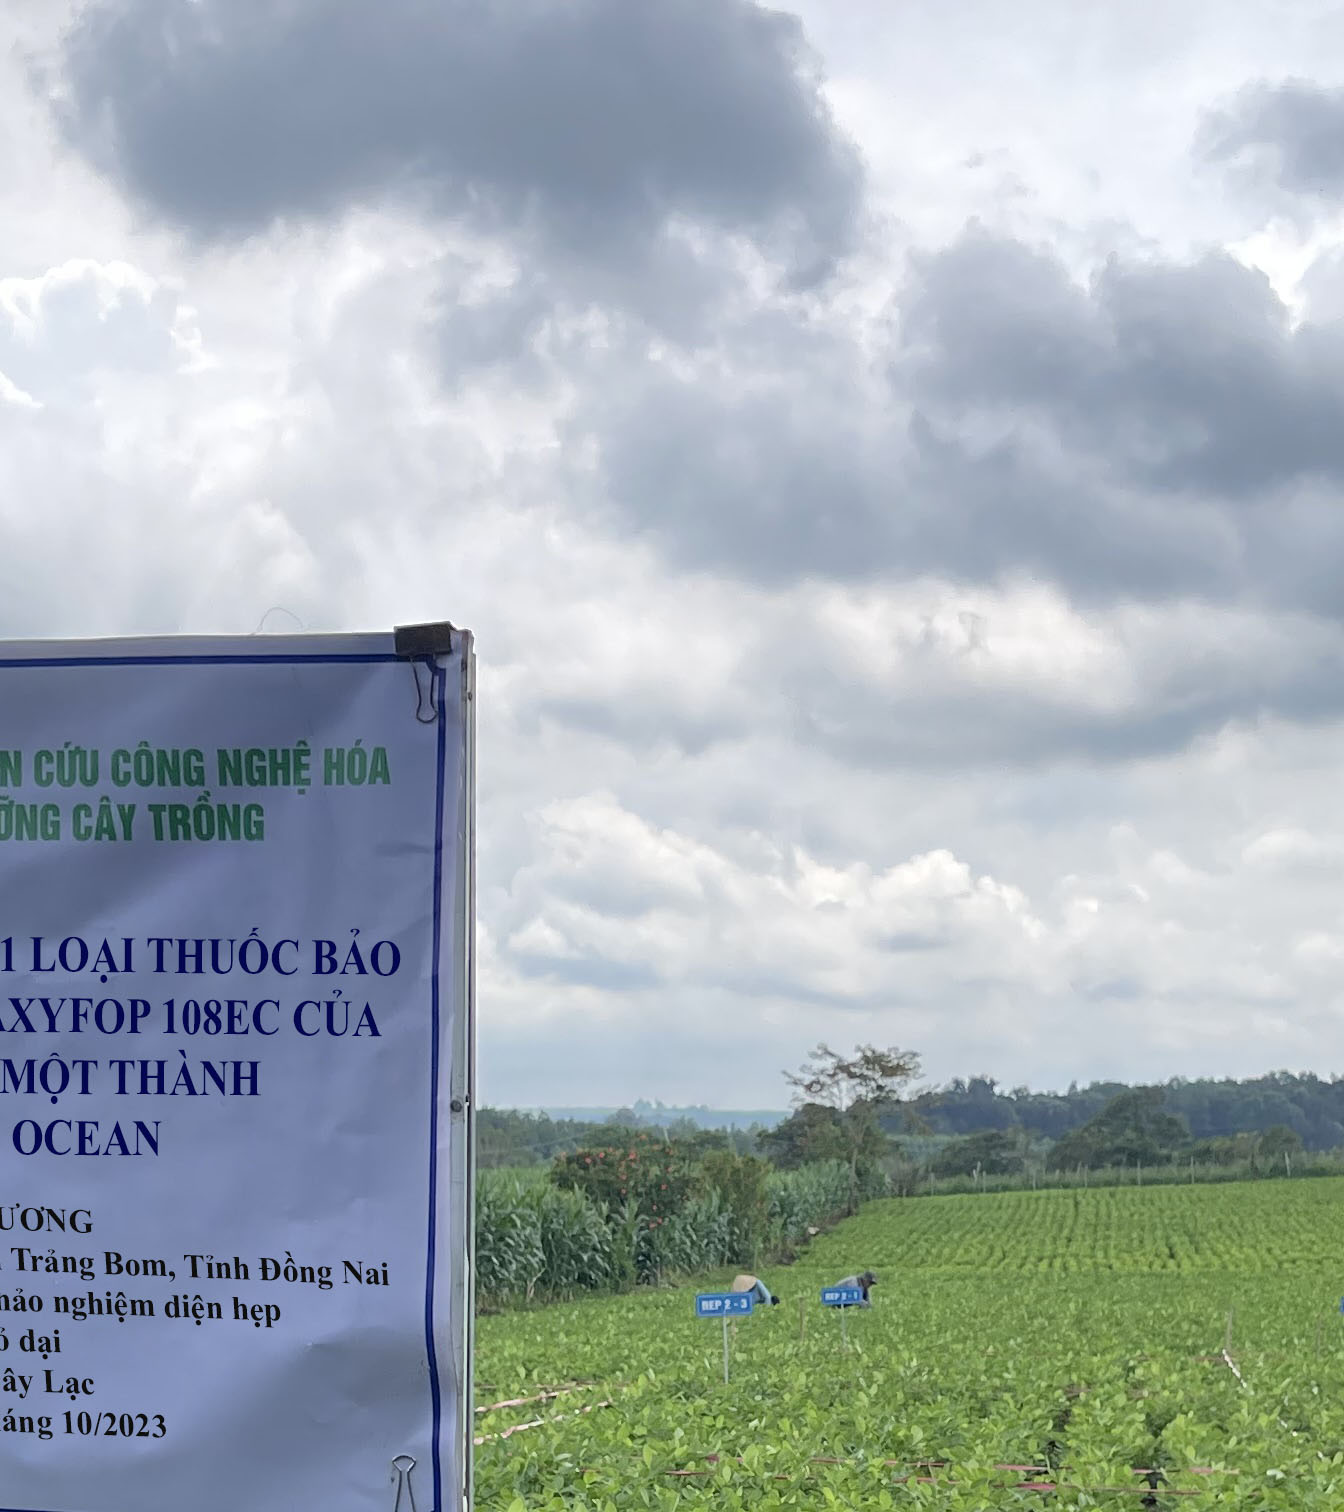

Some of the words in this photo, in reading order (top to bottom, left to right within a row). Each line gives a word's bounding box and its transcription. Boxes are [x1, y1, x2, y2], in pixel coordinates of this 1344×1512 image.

[33, 742, 99, 787] CỨU
[111, 741, 205, 787] CÔNG
[217, 740, 311, 794] NGHỆ
[324, 739, 391, 786] HÓA
[72, 796, 136, 841] CÂY
[148, 790, 264, 841] TRỒNG
[29, 937, 136, 983] LOẠI
[147, 927, 299, 974] THUỐC
[312, 928, 401, 976] BẢO
[162, 998, 280, 1036] 108EC
[293, 989, 382, 1037] CỦA
[0, 1052, 98, 1104] MỘT
[109, 1049, 261, 1096] THÀNH
[12, 1119, 161, 1157] OCEAN
[11, 1248, 95, 1281] Trảng
[104, 1252, 176, 1283] Bom,
[184, 1254, 250, 1280] Tỉnh
[259, 1251, 333, 1290] Đồng
[342, 1260, 390, 1286] Nai
[54, 1292, 155, 1322] nghiệm
[165, 1295, 223, 1326] diện
[232, 1297, 281, 1328] hẹp
[19, 1329, 61, 1359] dại
[42, 1369, 95, 1401] Lạc
[62, 1411, 167, 1438] 10/2023
